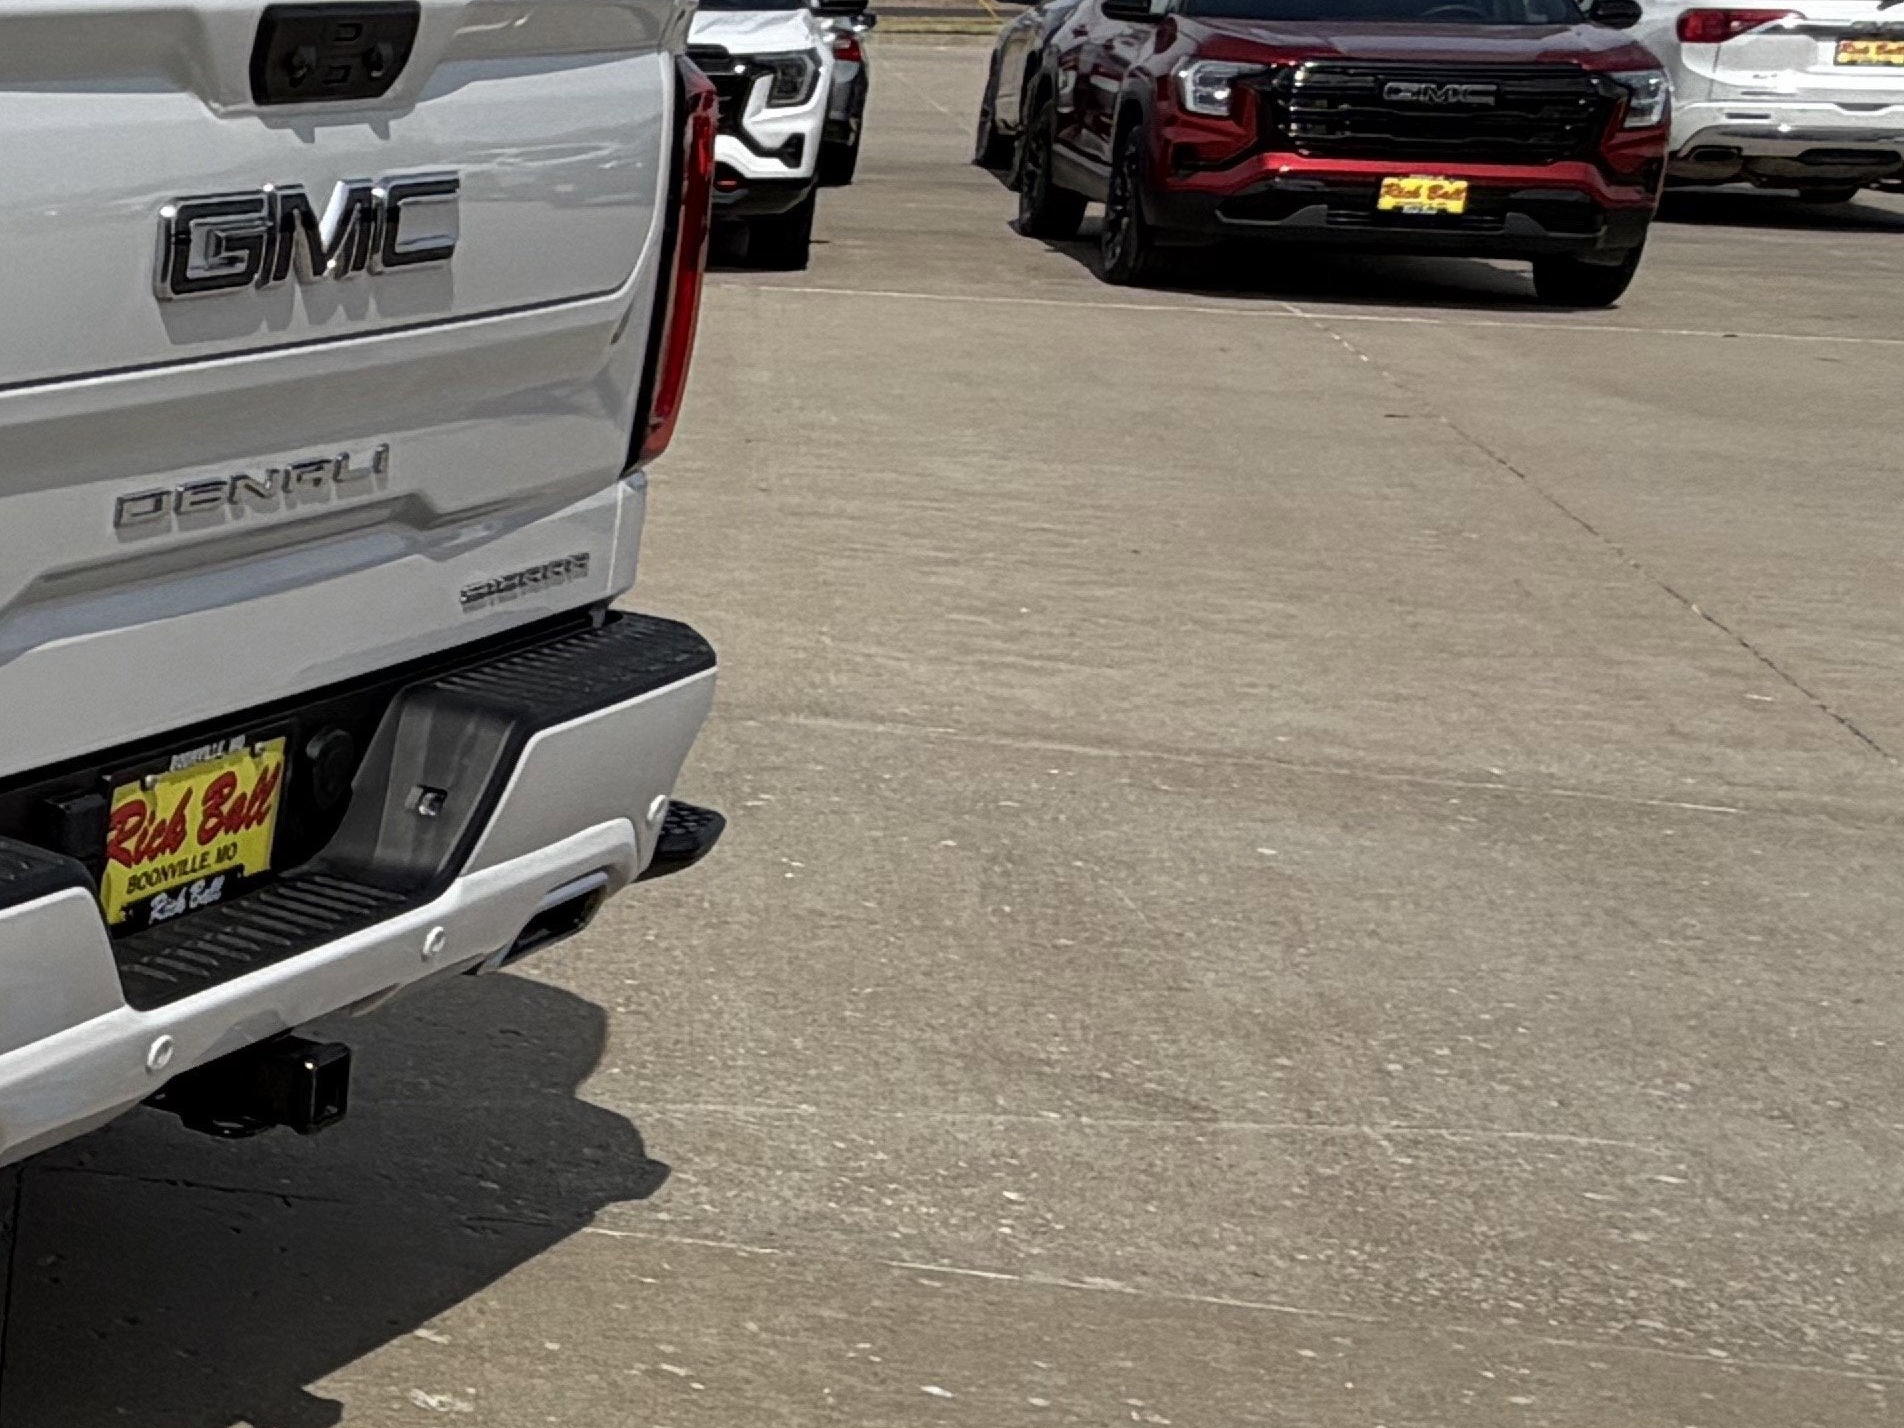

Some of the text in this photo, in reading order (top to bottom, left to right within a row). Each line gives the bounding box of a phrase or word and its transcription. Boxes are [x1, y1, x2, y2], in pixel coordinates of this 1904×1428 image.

[153, 171, 460, 302] GMC
[113, 443, 390, 529] DENALI
[107, 761, 282, 869] Rick Ball
